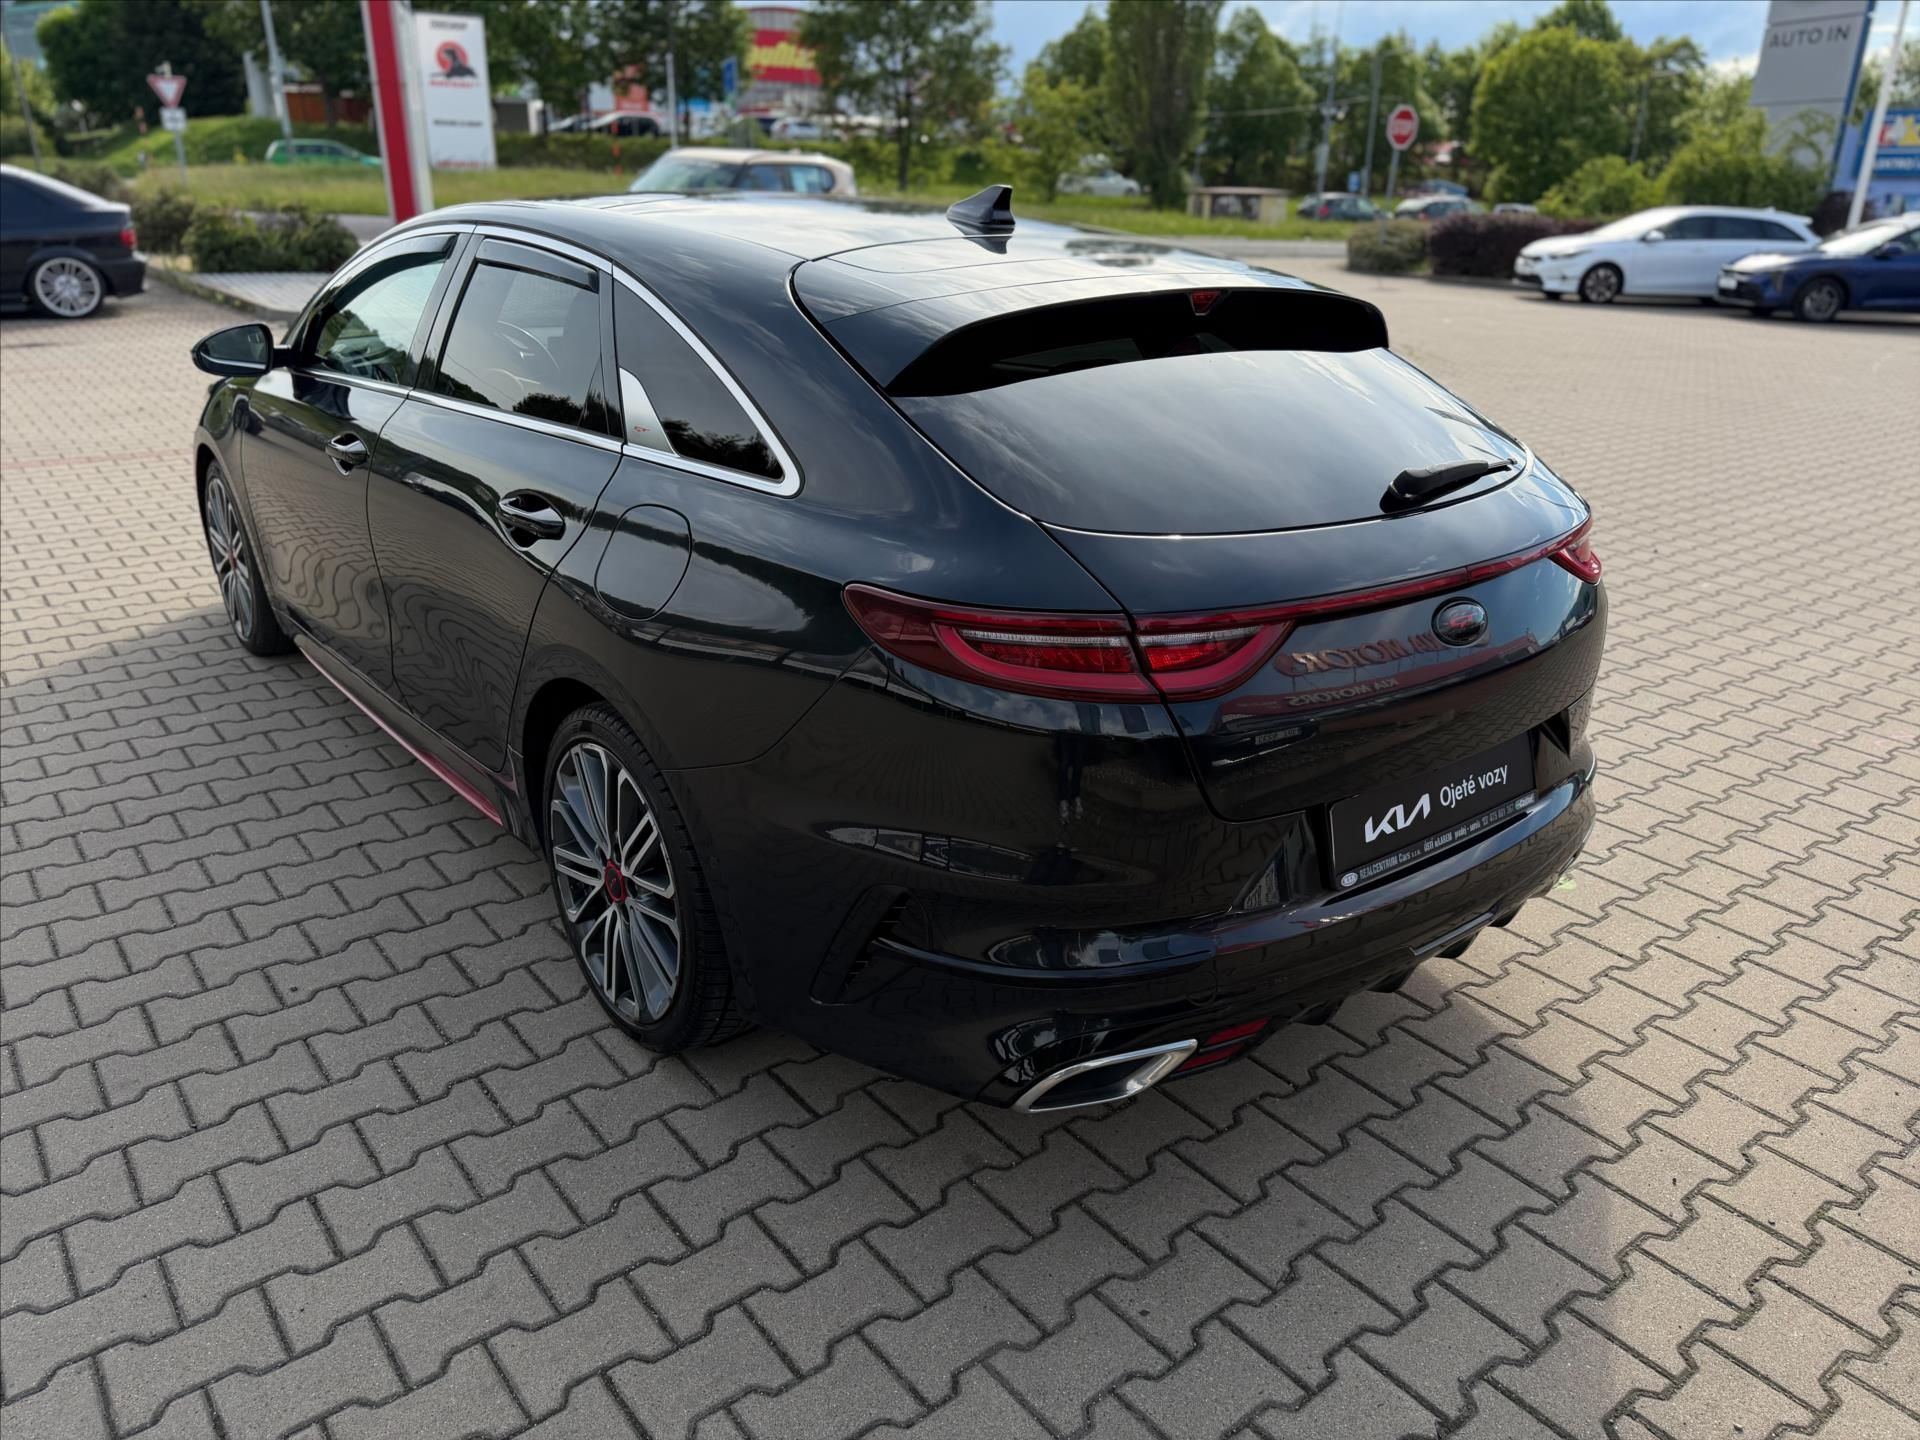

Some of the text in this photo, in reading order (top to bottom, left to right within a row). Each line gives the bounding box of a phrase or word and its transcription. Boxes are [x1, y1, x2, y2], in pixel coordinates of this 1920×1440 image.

[1770, 24, 1850, 48] AUTO IN
[1364, 793, 1431, 843] KIA
[1439, 774, 1476, 808] Ojeté
[1477, 764, 1508, 790] vozy
[1360, 855, 1398, 880] REALCENTRUM
